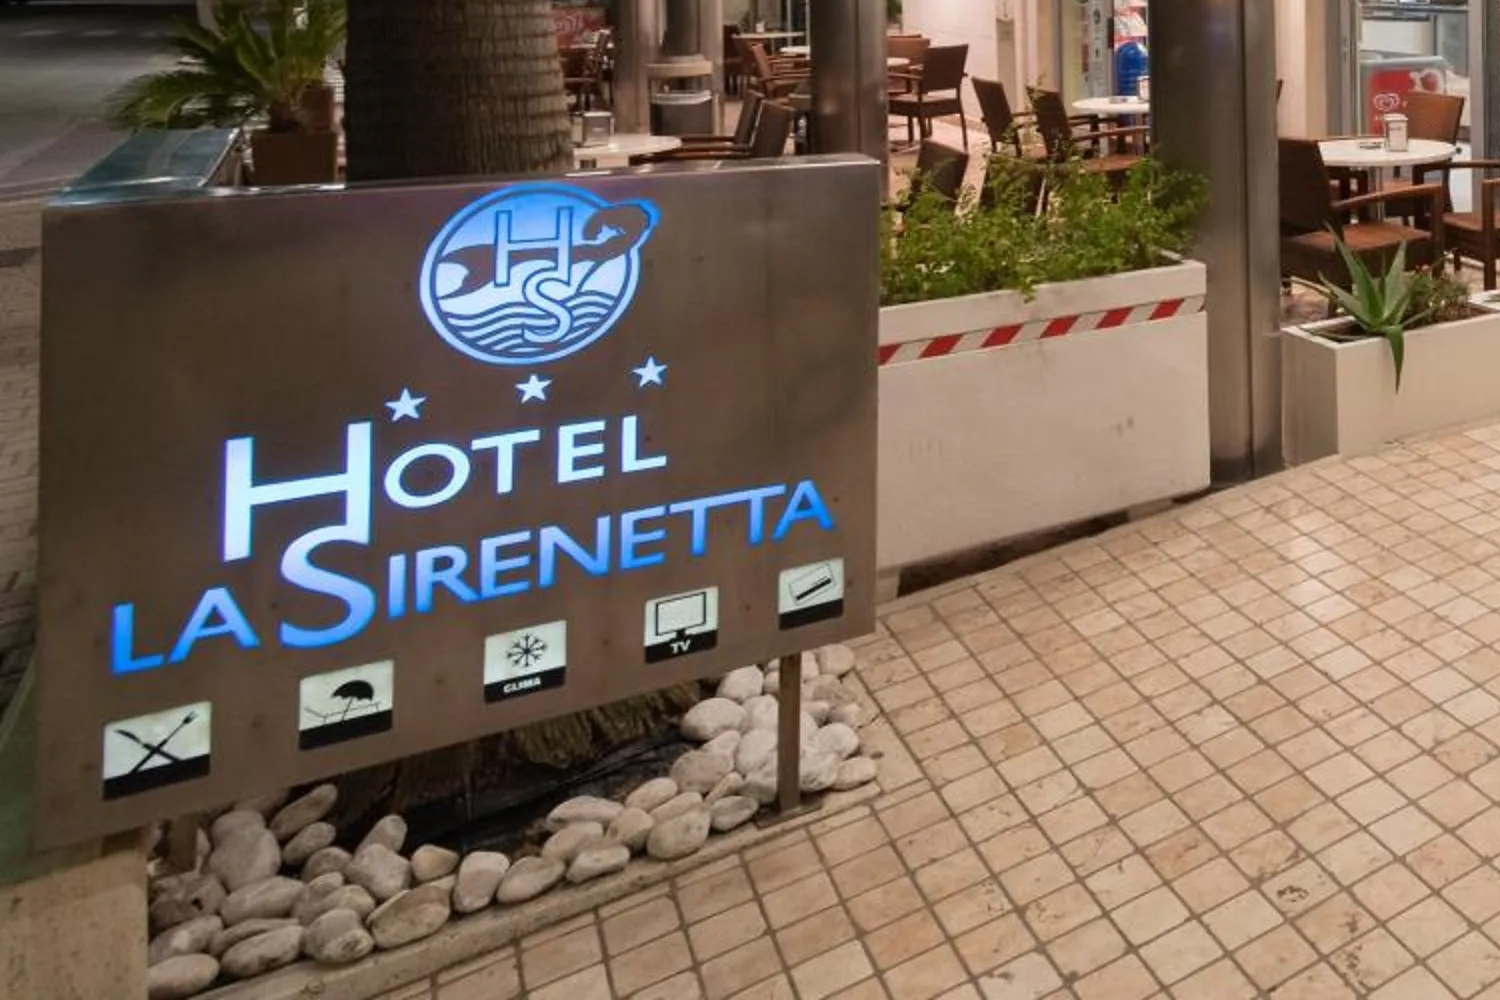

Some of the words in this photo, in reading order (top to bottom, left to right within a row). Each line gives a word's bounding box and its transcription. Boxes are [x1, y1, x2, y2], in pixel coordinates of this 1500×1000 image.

[222, 414, 668, 562] HOTEL
[110, 586, 260, 676] LA
[278, 479, 836, 648] SIRENETTA
[503, 677, 541, 693] CLIMA
[670, 640, 691, 654] TV
